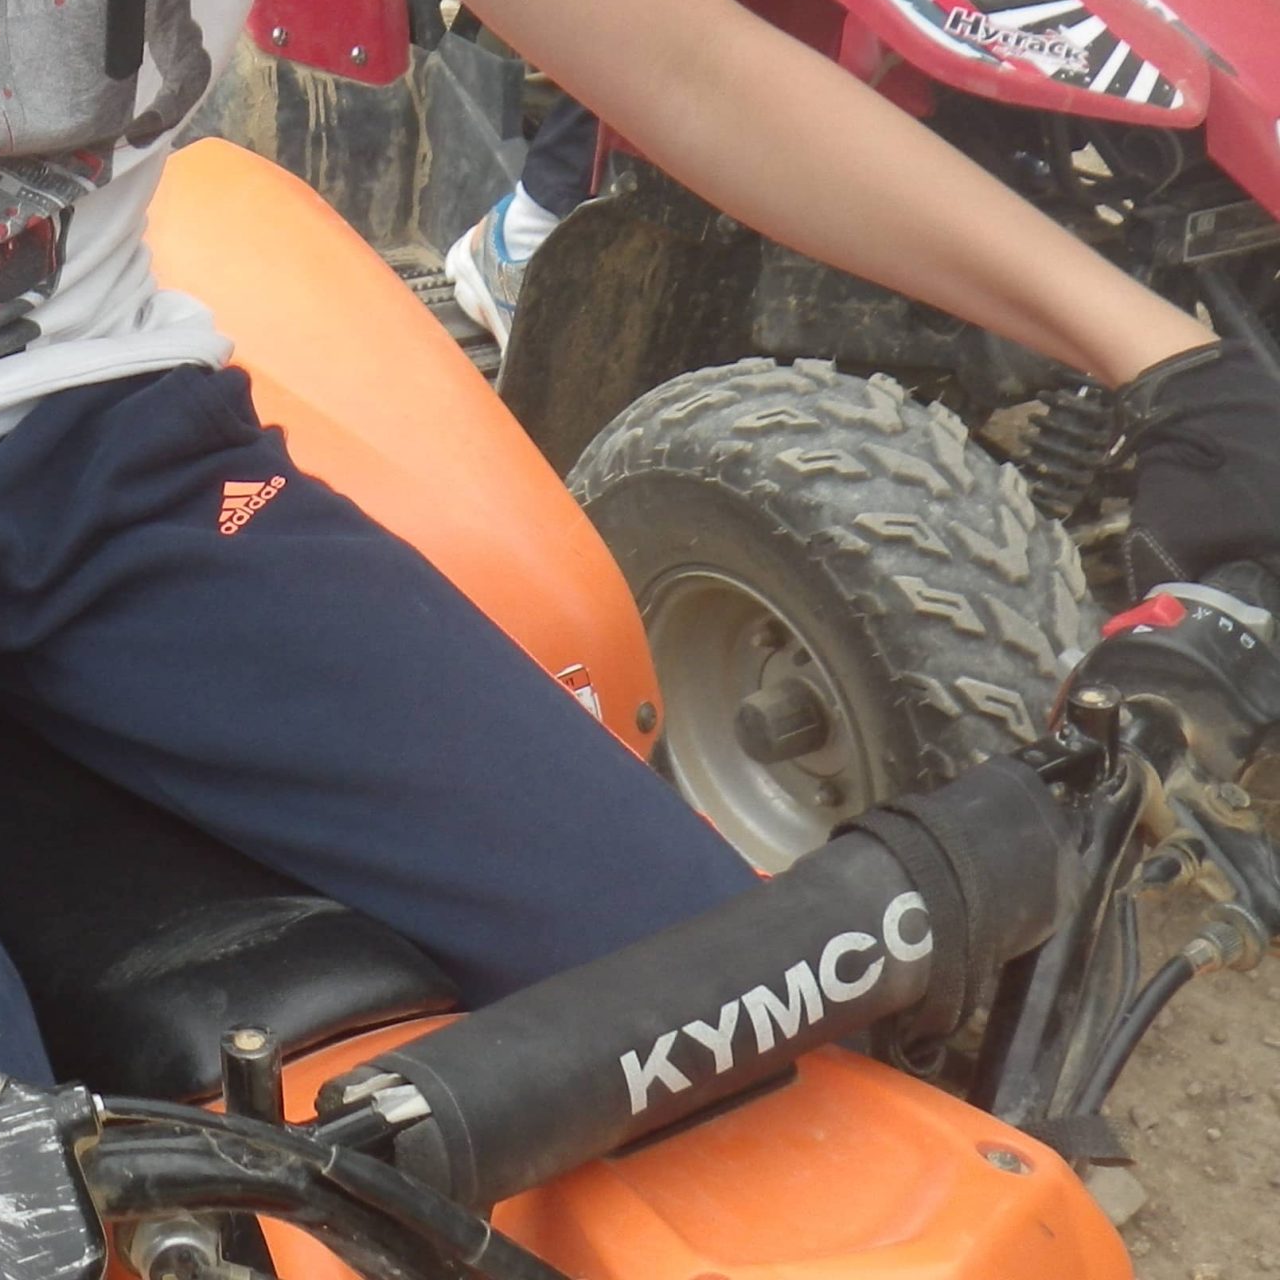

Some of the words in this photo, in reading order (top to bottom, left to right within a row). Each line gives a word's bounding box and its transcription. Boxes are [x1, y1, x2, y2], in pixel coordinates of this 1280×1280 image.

[947, 7, 1089, 65] Hytrack
[220, 476, 286, 535] adidas
[619, 891, 933, 1115] KYMCO
